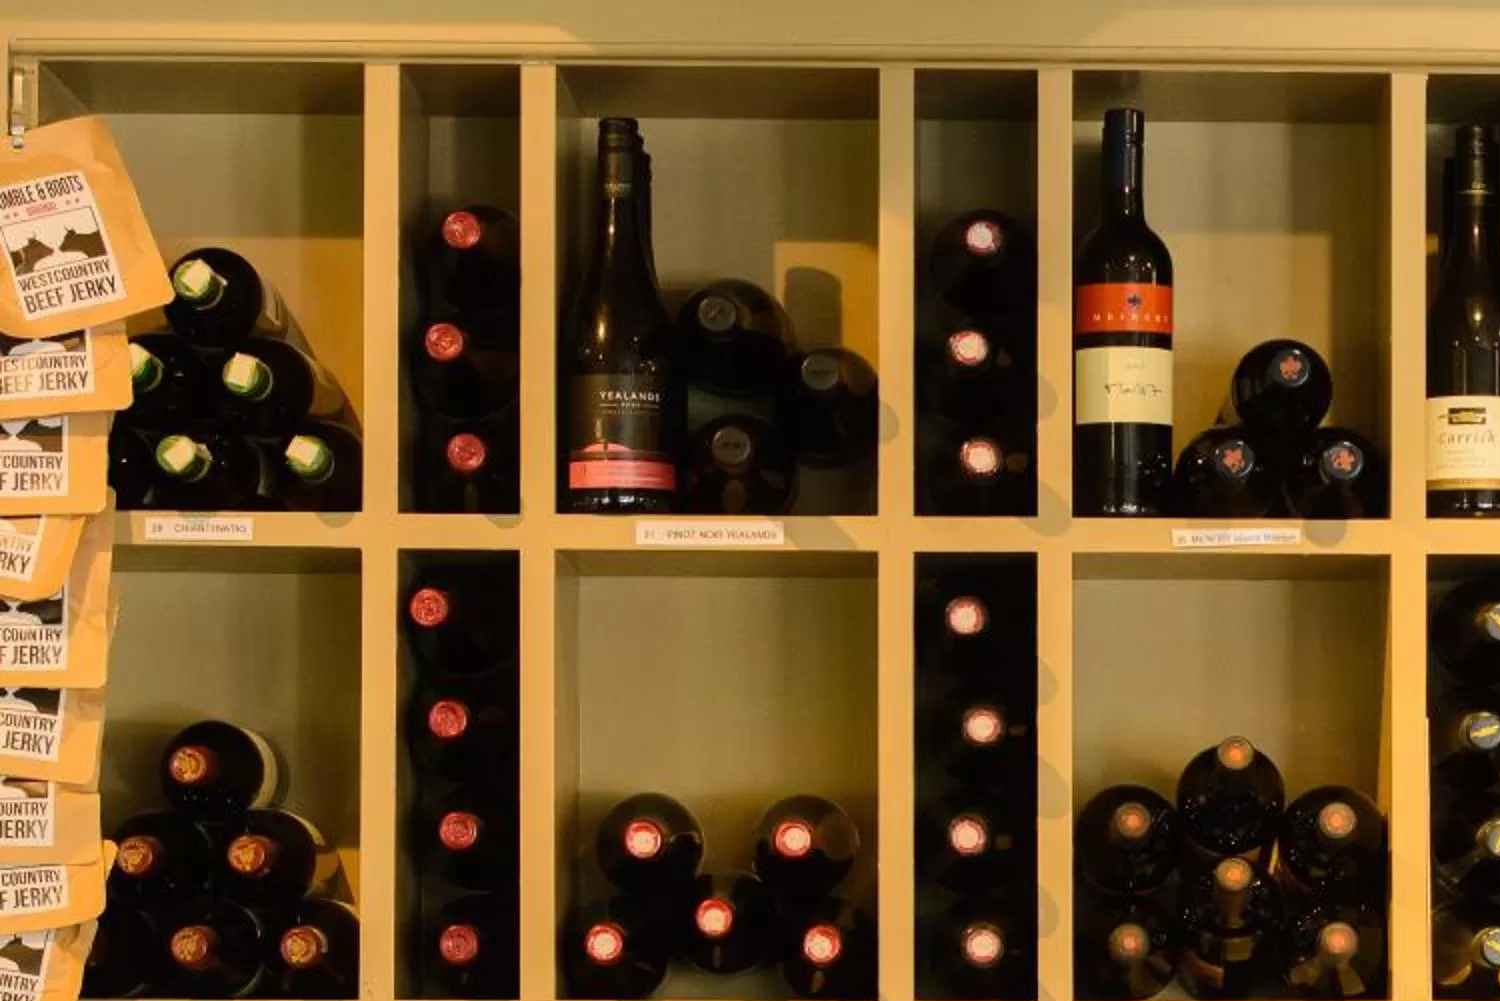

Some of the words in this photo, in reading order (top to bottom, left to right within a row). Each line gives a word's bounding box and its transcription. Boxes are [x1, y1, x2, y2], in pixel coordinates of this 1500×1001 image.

[45, 175, 84, 198] BOOTS
[18, 259, 111, 292] WESTCOUNTRY
[23, 286, 67, 314] BEEF
[69, 275, 118, 304] JERKY
[0, 355, 87, 372] ESTCOUNTRY
[0, 375, 33, 394] EEF
[40, 370, 88, 391] JERKY
[13, 473, 63, 491] JERKY
[11, 645, 63, 665] JERKY
[2, 731, 55, 754] JERKY
[13, 885, 63, 908] JERKY
